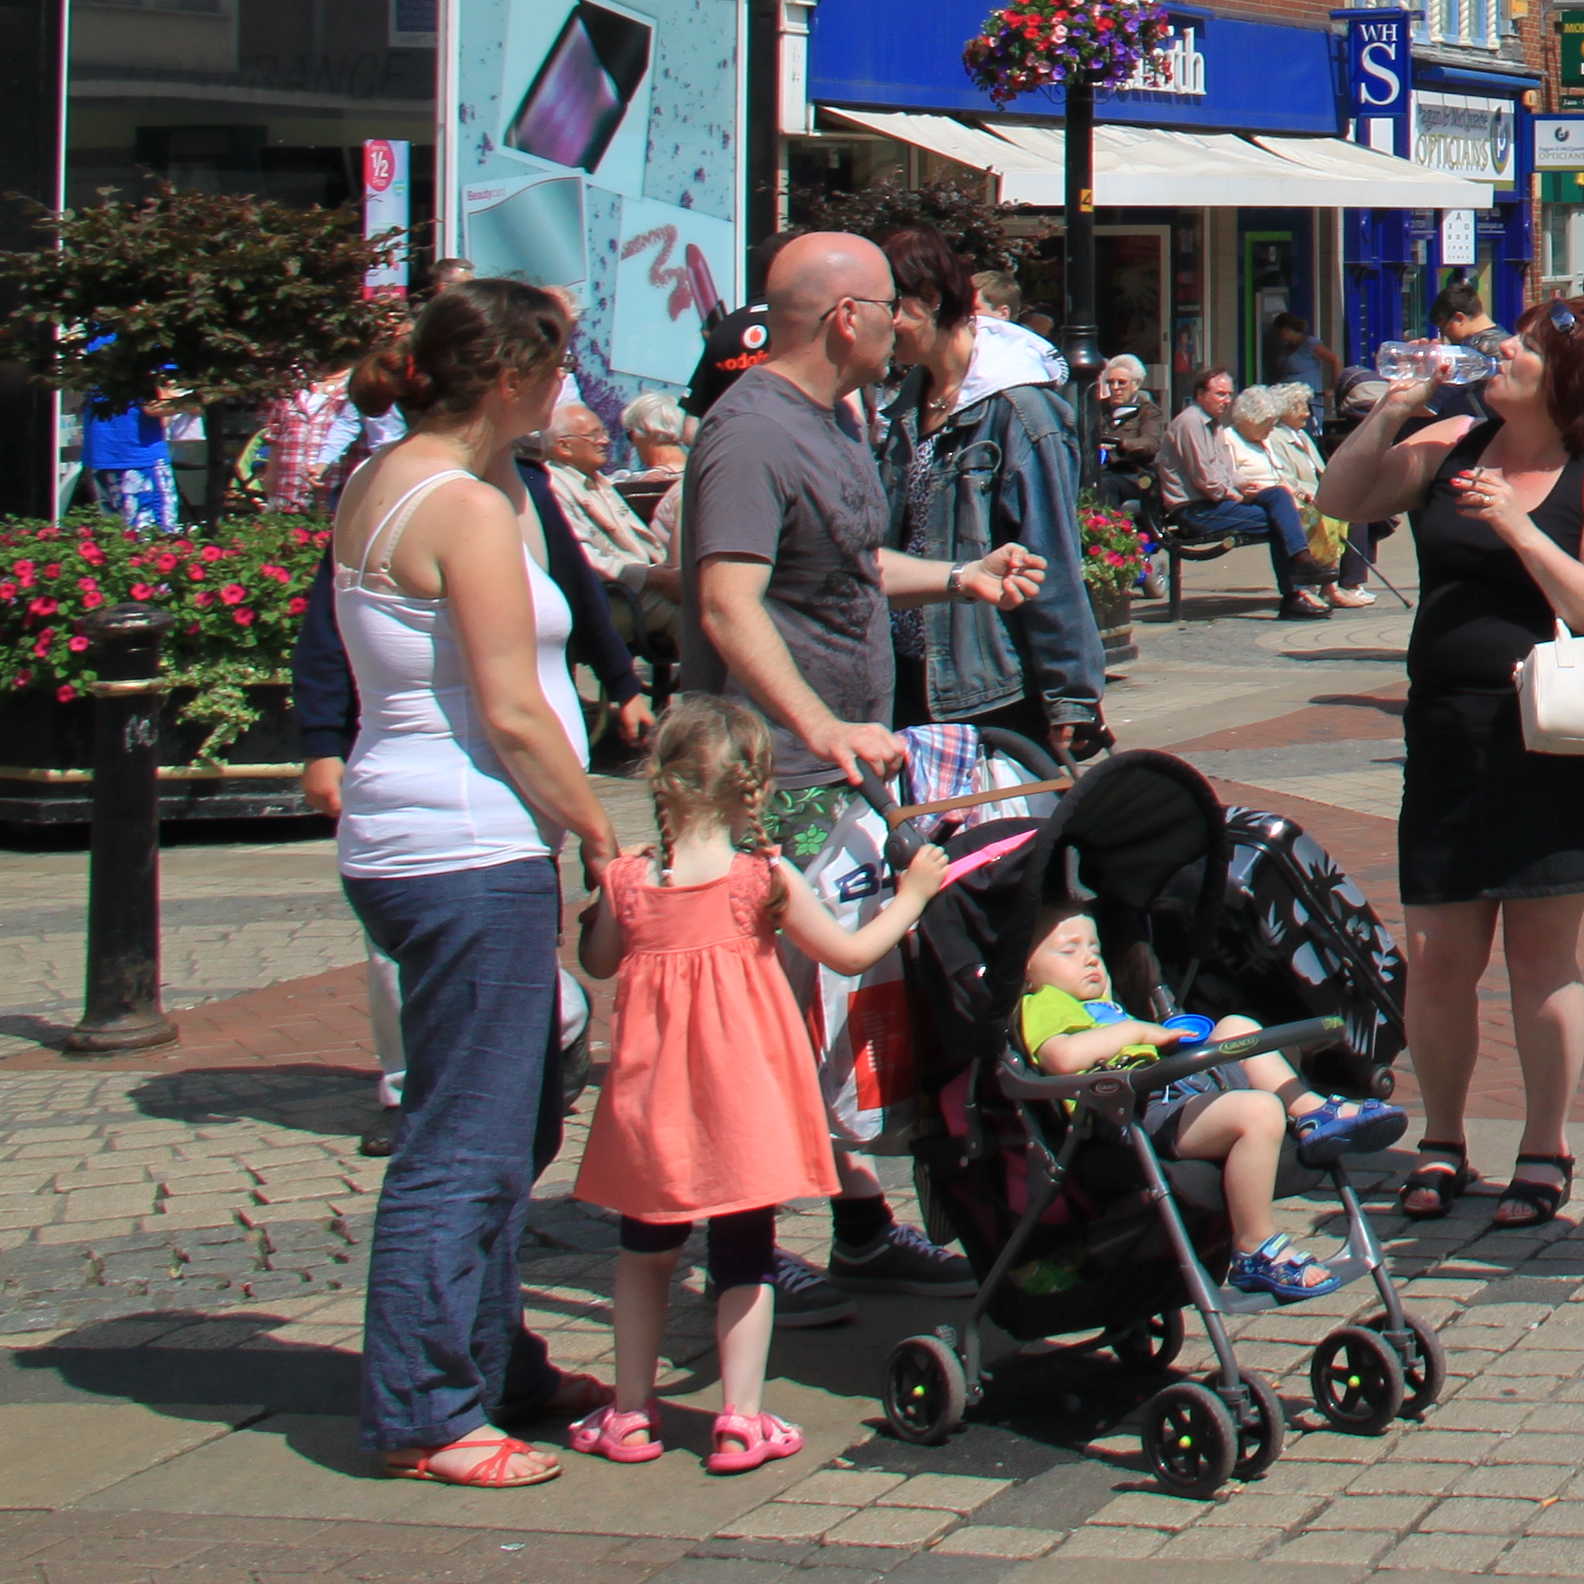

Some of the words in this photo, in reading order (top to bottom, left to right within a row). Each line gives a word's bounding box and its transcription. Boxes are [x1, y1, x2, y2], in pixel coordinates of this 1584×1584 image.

[1360, 23, 1398, 42] WH
[1361, 42, 1400, 106] S
[1416, 133, 1489, 168] OPTICIANS
[1082, 192, 1091, 205] 4
